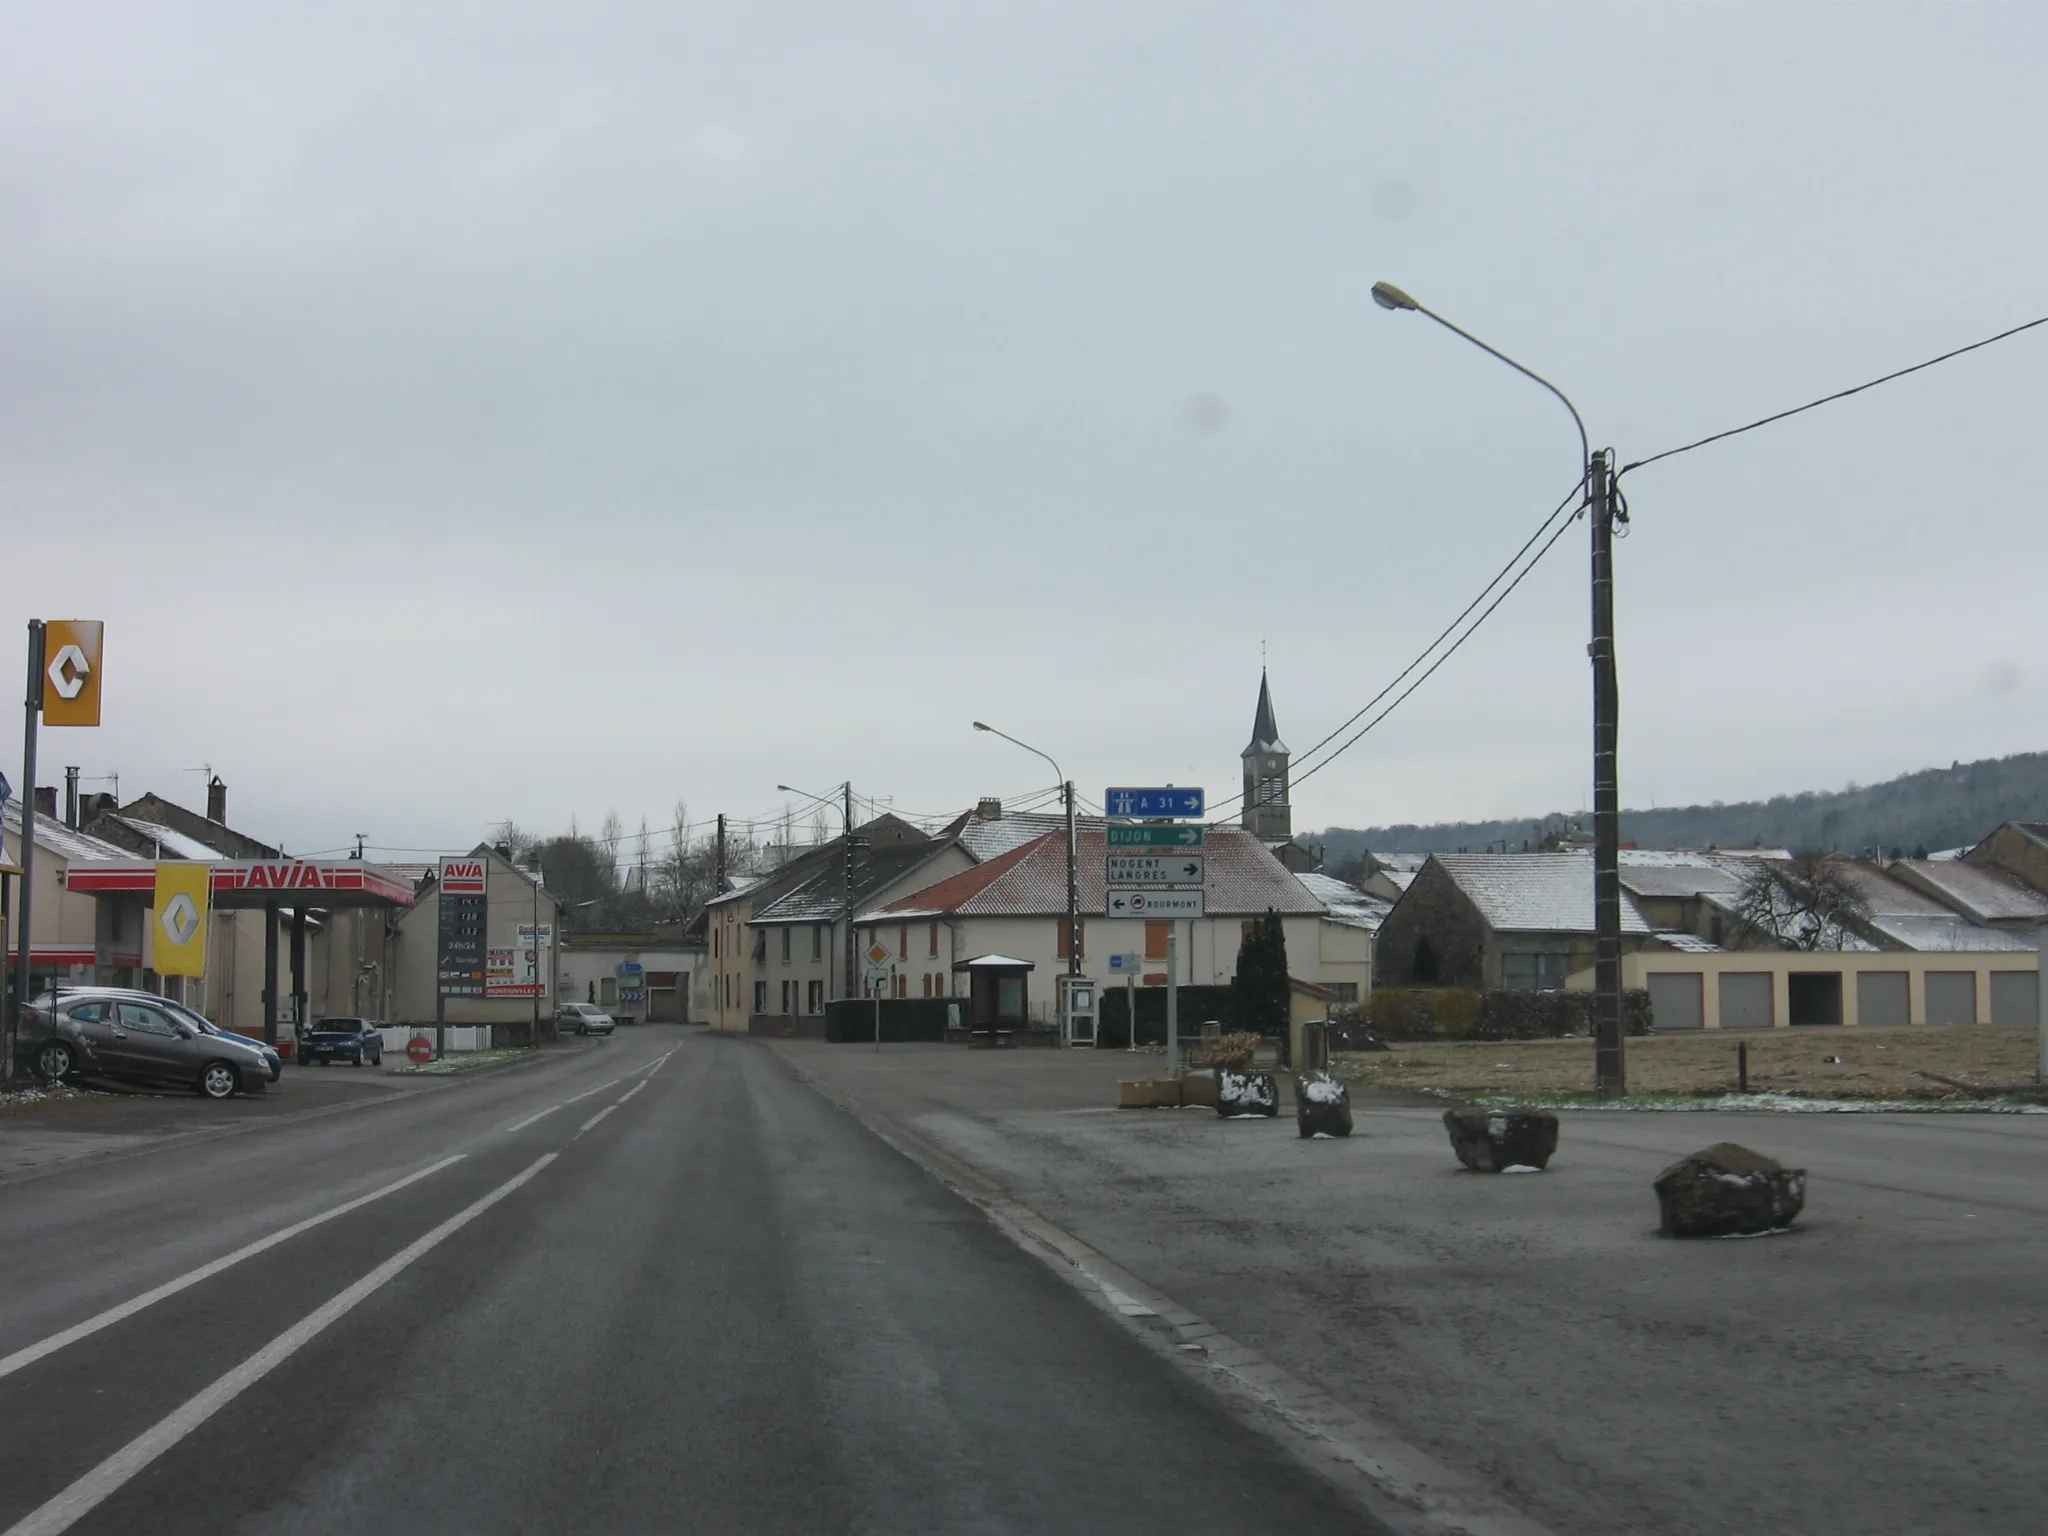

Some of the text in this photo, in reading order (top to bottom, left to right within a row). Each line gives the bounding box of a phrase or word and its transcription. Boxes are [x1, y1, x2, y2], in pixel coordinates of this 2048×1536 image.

[1140, 797, 1173, 808] A 31
[1111, 831, 1152, 842] DIJON
[1111, 859, 1160, 868] NOGENT
[248, 861, 321, 888] AVIA
[444, 862, 483, 877] AVIA
[1111, 870, 1167, 880] LANGRES
[1147, 900, 1197, 908] BOURMONT
